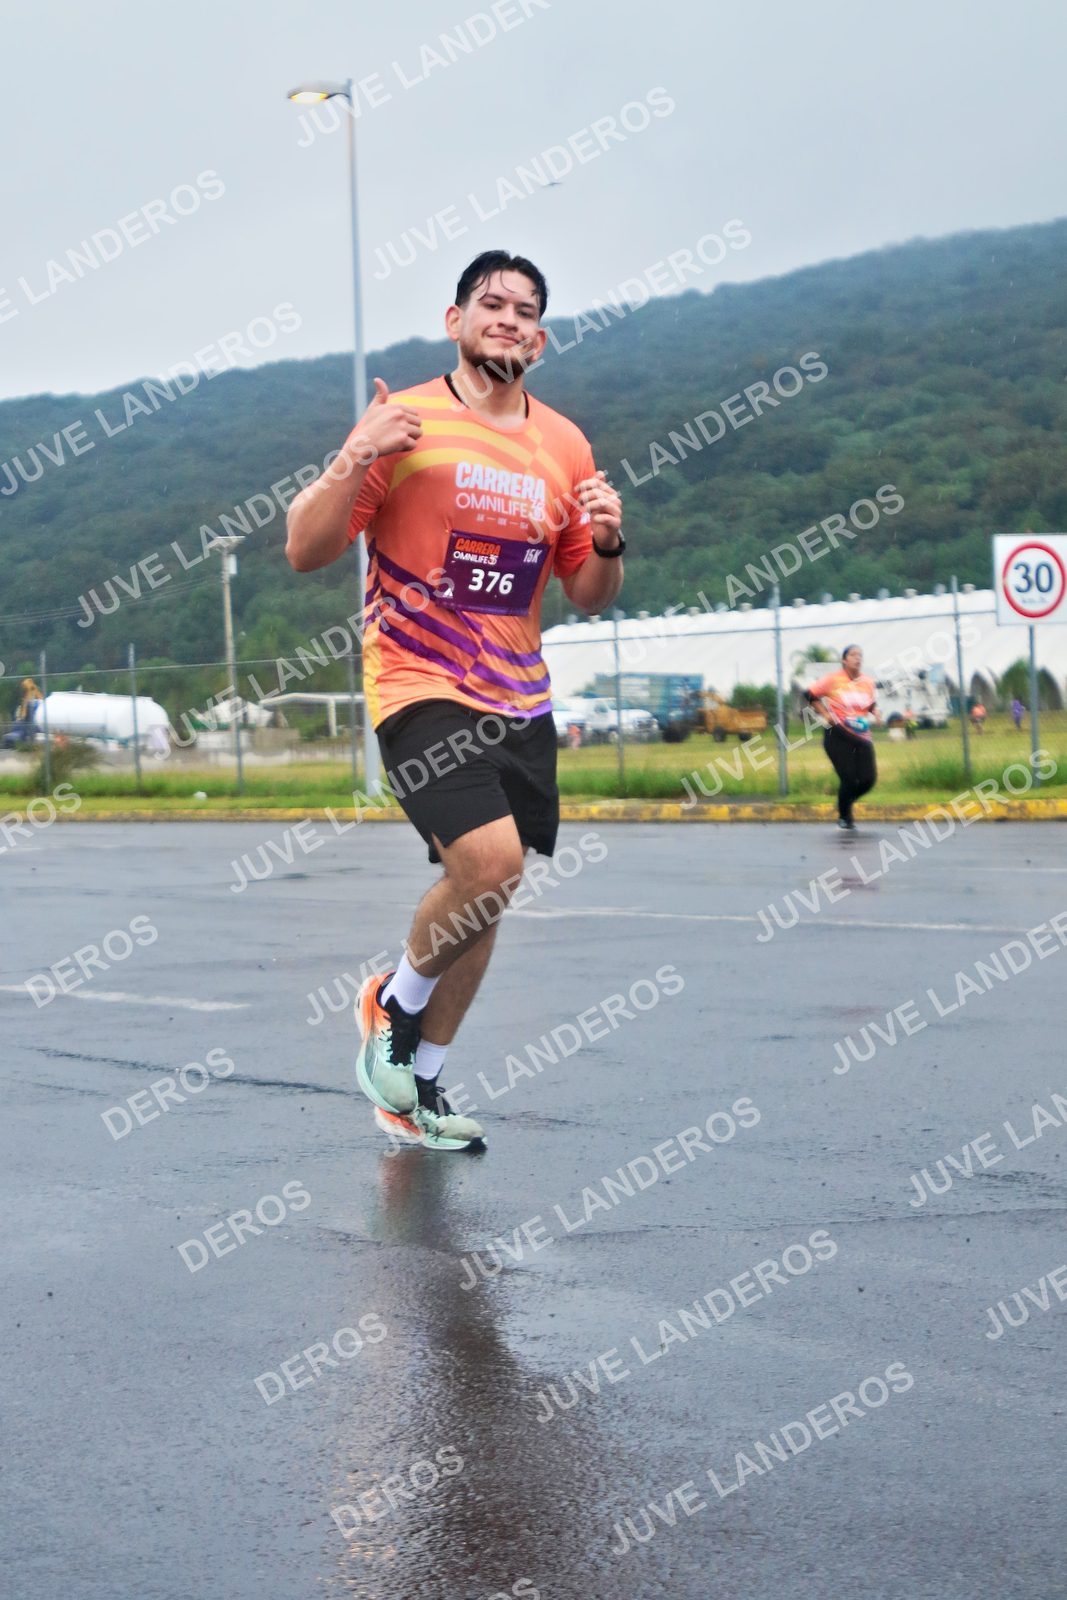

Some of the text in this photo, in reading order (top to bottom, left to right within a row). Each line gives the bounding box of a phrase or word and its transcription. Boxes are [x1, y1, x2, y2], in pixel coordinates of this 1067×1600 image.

[456, 461, 545, 502] CARRERA
[455, 537, 501, 556] CARRERA
[523, 549, 542, 563] 15K
[469, 569, 514, 594] 376
[1014, 562, 1054, 593] 30
